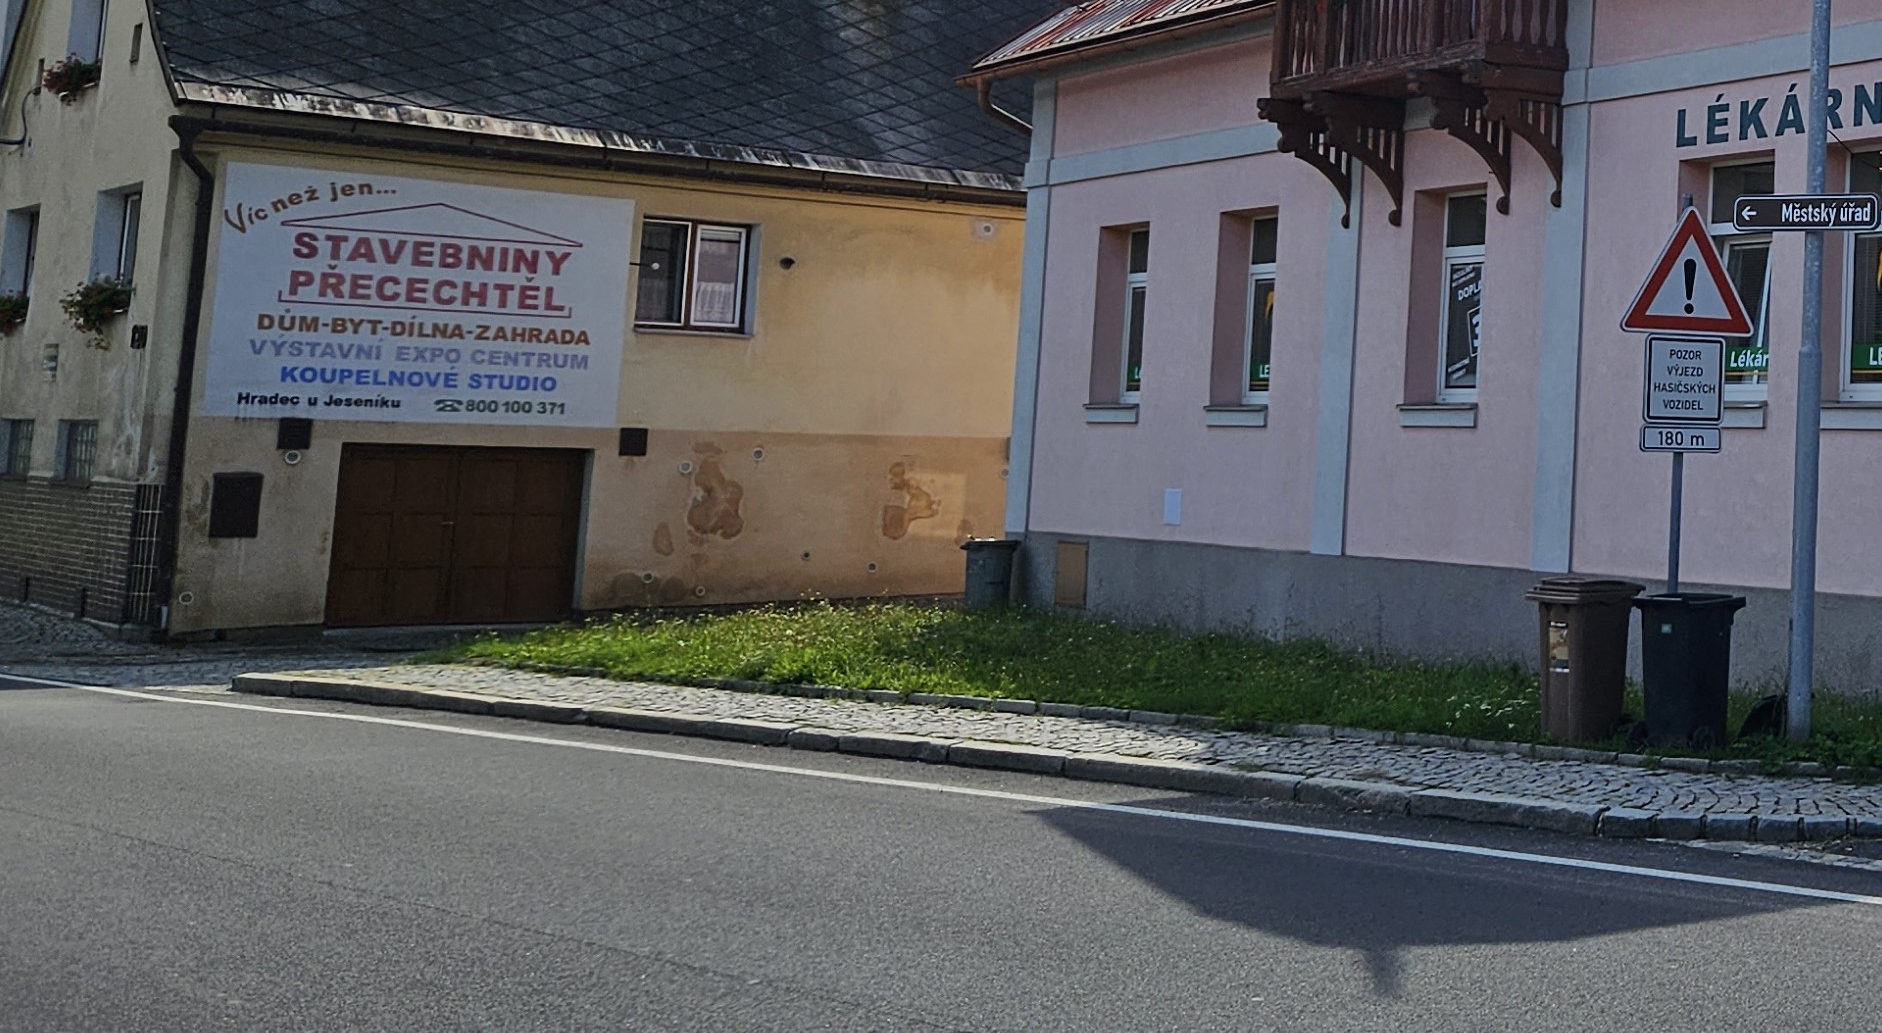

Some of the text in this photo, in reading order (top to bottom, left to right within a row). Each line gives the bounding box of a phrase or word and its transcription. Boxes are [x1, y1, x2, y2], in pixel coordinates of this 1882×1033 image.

[330, 182, 397, 202] jen...
[1781, 202, 1871, 227] Městský úřad
[292, 232, 572, 276] STAVEBNINY
[288, 264, 566, 312] PŘECECHTĚL
[257, 308, 591, 346] DŮM-BYT-DÍLNA-ZAHRADA
[249, 334, 590, 370] VÝSTAVNÍ EXPO CENTRUM
[1669, 349, 1702, 360] POZOR
[280, 366, 557, 392] KOUPELNOVÉ STUDIO
[1667, 364, 1704, 377] VÝJEZD
[1653, 380, 1716, 394] HASIČSKÝCH
[237, 391, 401, 409] Hradec u Jeseníku
[465, 399, 566, 415] 800 100 371
[1663, 399, 1703, 411] VOZIDEL
[1658, 430, 1705, 446] 180 m
